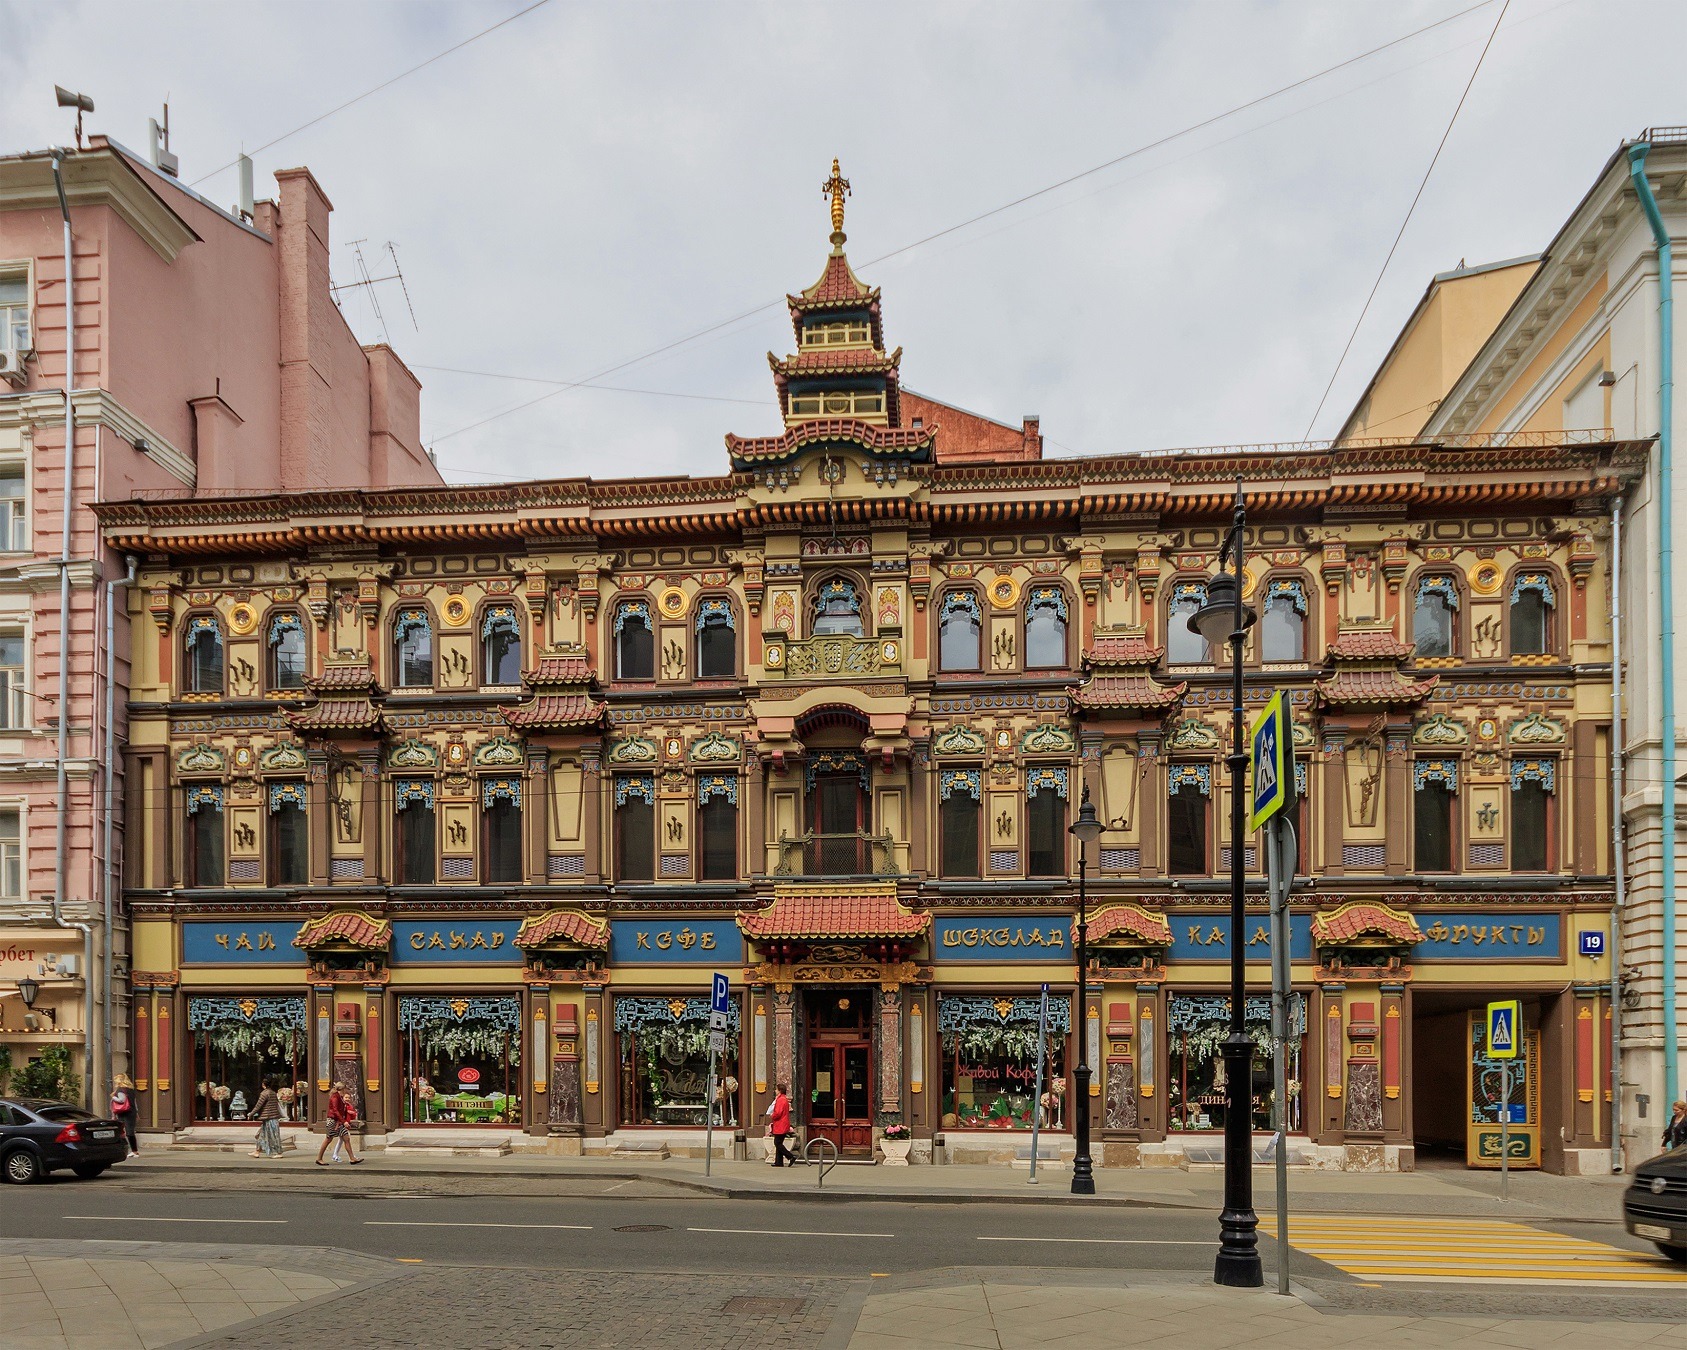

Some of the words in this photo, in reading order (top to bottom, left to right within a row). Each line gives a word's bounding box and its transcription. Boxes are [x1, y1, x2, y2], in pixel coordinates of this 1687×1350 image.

[214, 931, 276, 951] ЧАЙ
[409, 930, 505, 950] САХАР
[636, 927, 717, 950] КОФЕ
[943, 927, 1065, 949] ШОКОЛАД
[1188, 925, 1293, 946] КАА
[1426, 920, 1546, 945] ФРУКТЫ
[1585, 936, 1601, 949] 19
[716, 977, 727, 1008] P
[957, 1064, 999, 1079] Живой
